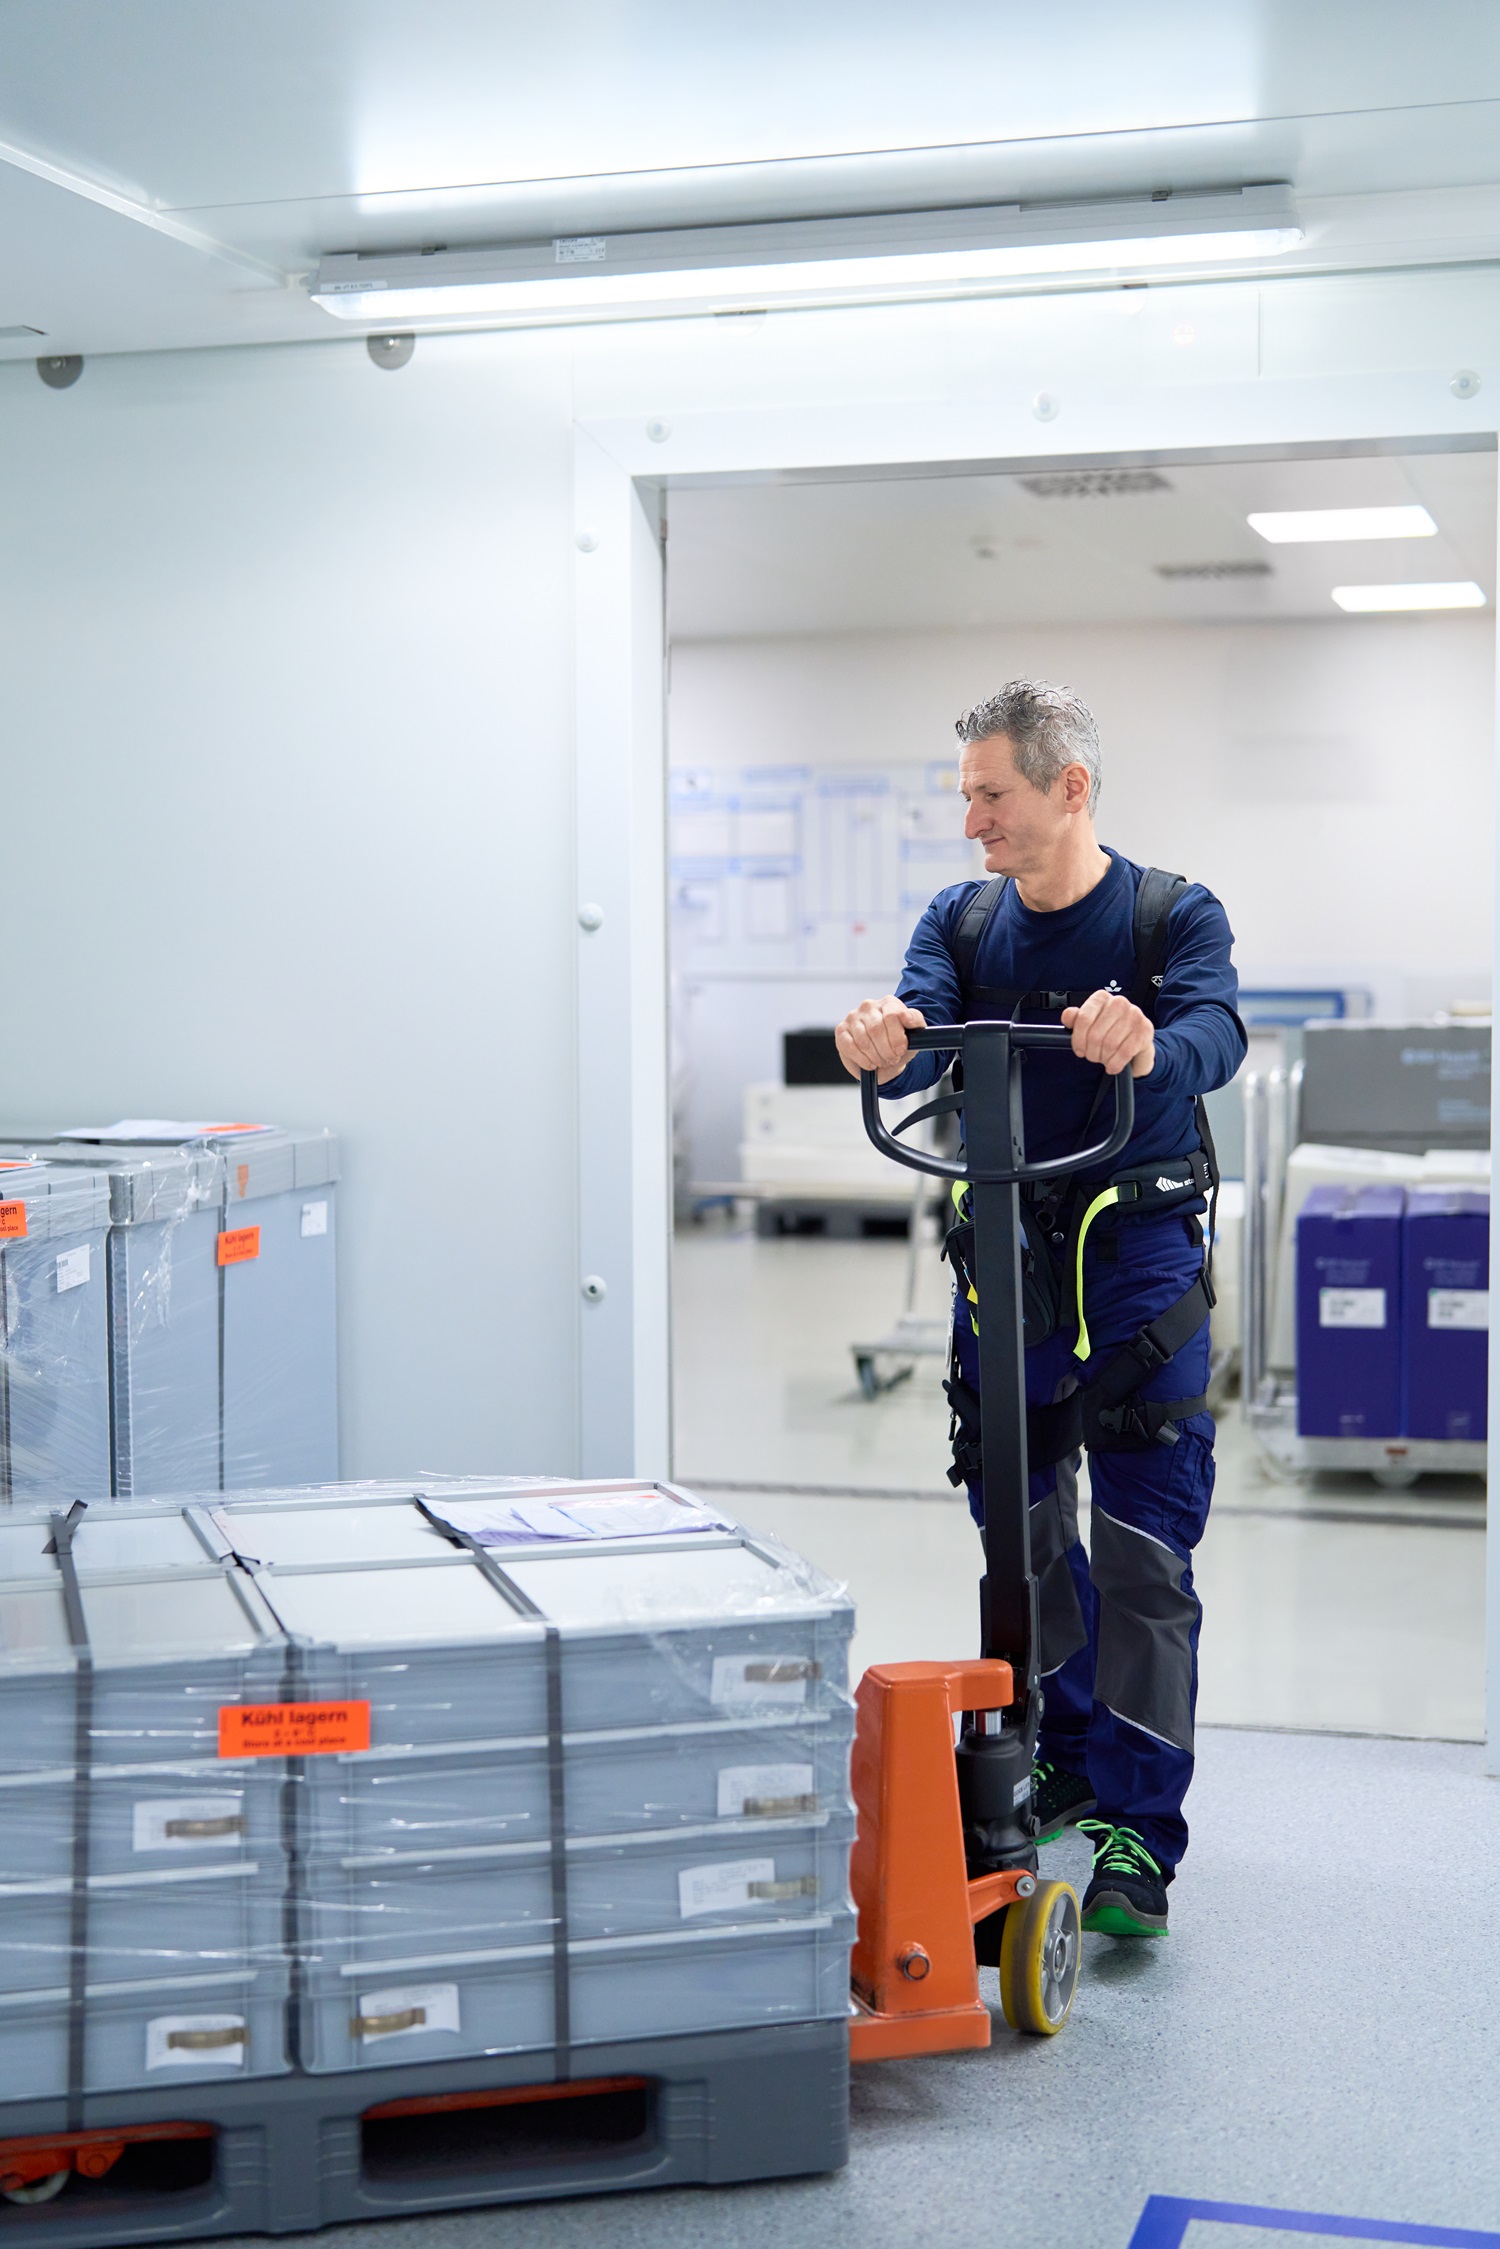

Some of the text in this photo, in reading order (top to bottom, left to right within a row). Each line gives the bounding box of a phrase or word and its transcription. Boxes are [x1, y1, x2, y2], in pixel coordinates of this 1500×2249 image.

[242, 1709, 348, 1727] Kühl lagern
[319, 1736, 346, 1746] place
